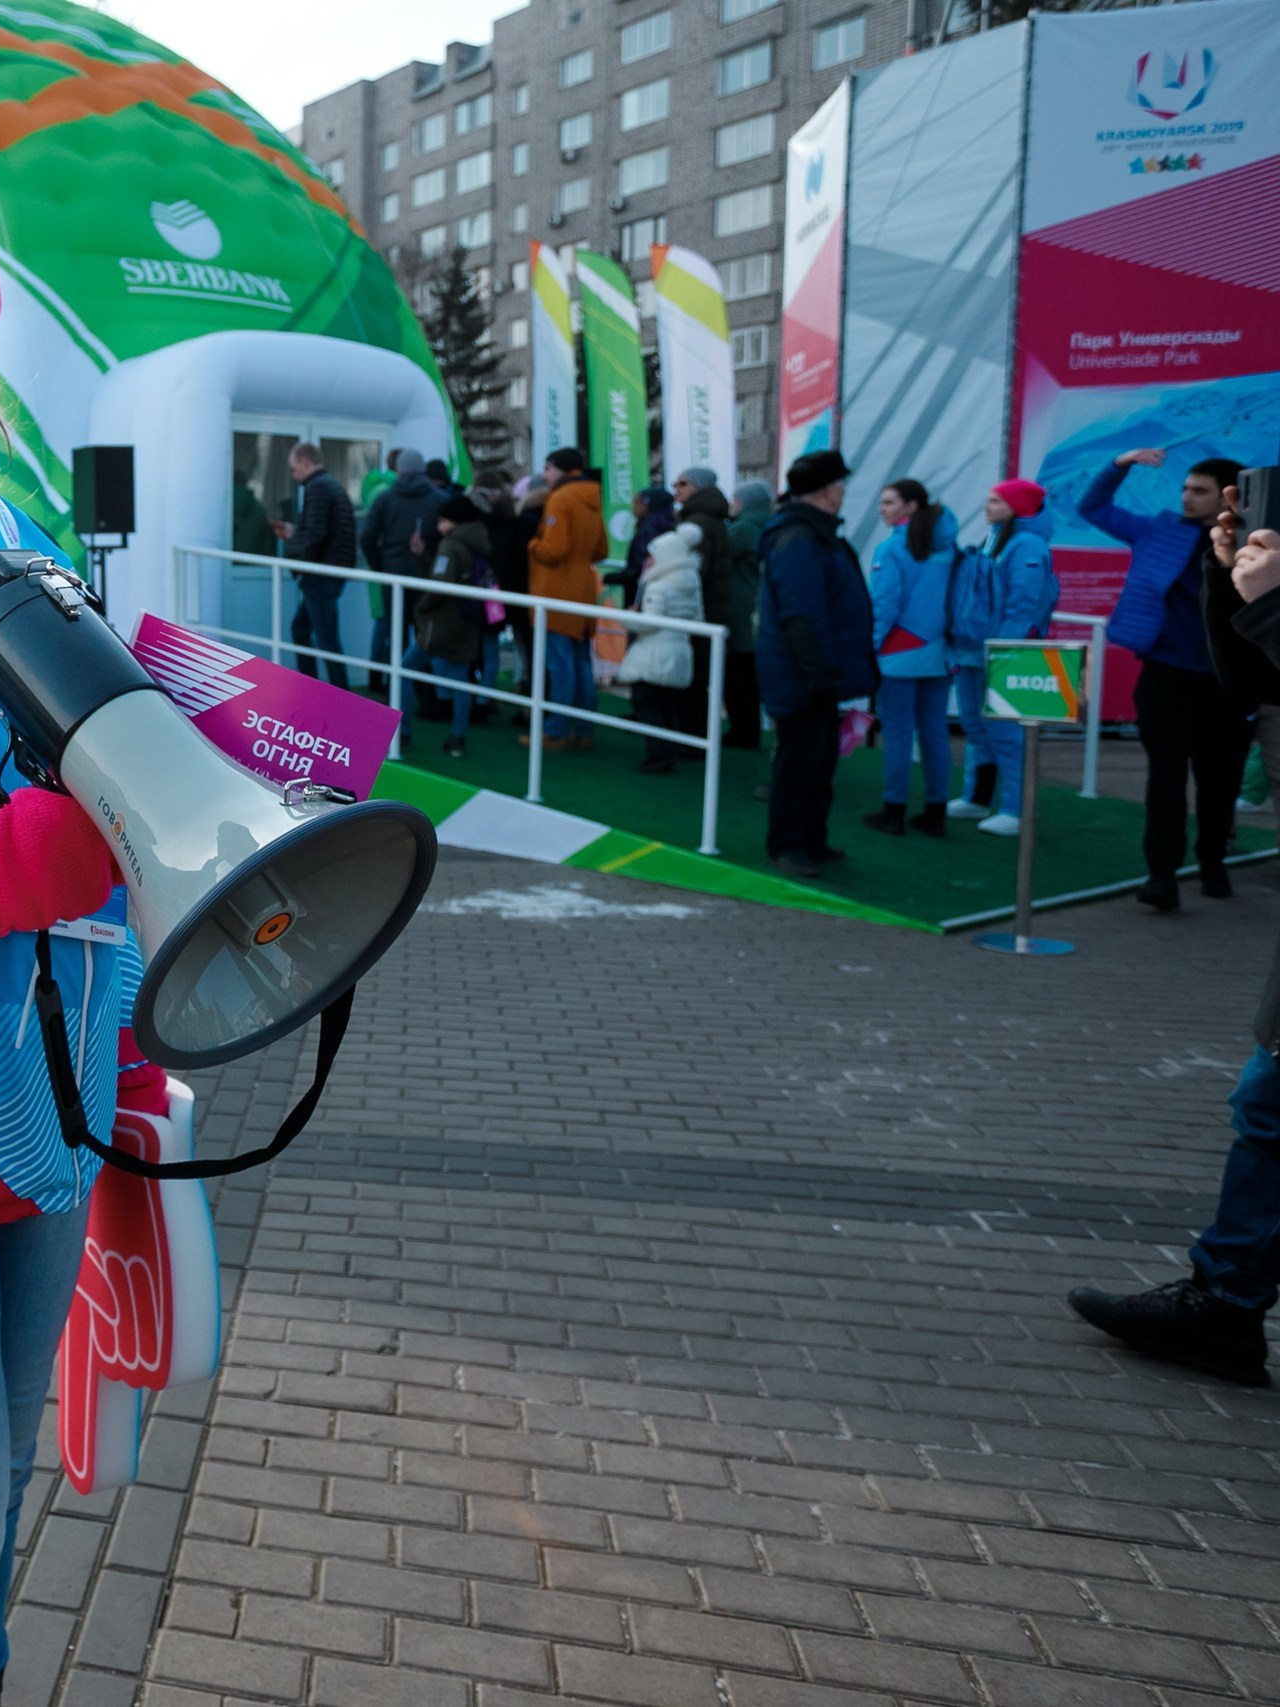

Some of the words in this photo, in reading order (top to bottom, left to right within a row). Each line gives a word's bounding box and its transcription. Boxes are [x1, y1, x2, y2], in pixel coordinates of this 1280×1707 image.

[1096, 123, 1206, 142] KRASNOYARSK
[1210, 120, 1245, 134] 2019
[119, 256, 291, 304] SBERBANK
[1069, 332, 1113, 351] Парк
[1120, 329, 1242, 347] Универсиады
[1069, 352, 1160, 370] Universiade
[1164, 350, 1200, 365] Park
[1006, 674, 1059, 693] ВХОД
[241, 709, 352, 767] ЭСТАФЕТА
[252, 738, 314, 777] ОГНЯ
[97, 795, 144, 888] ГОВОРИТЕЛЬ
